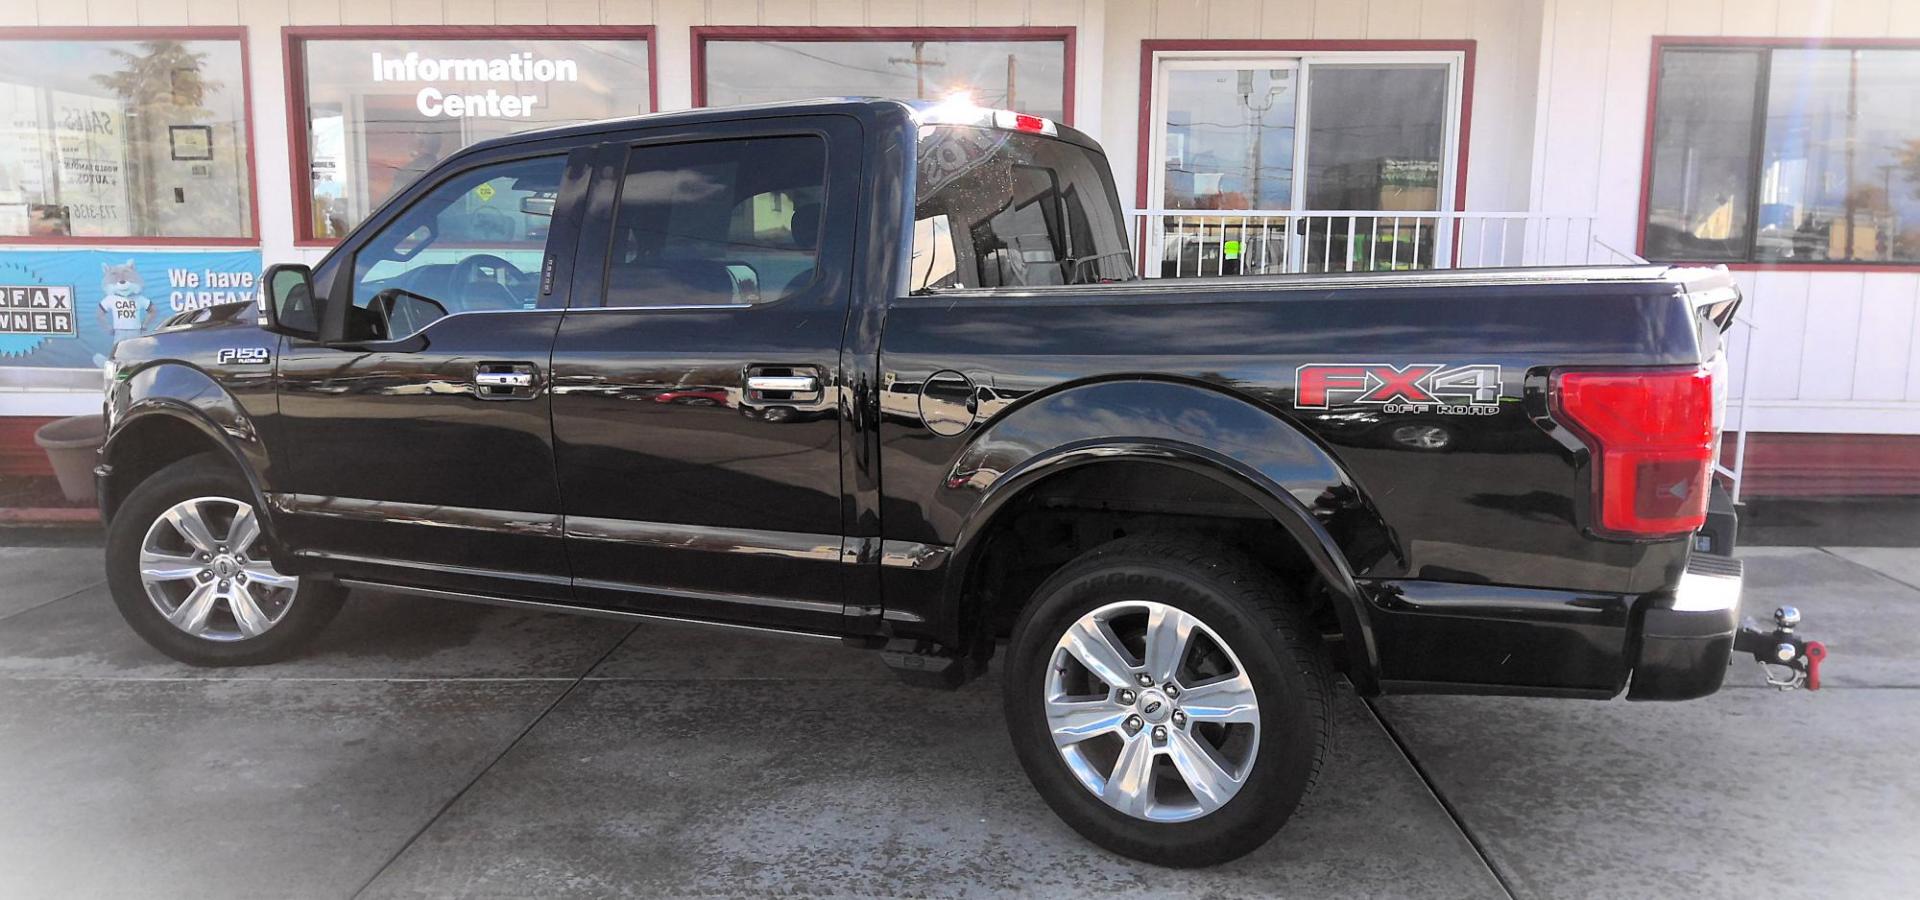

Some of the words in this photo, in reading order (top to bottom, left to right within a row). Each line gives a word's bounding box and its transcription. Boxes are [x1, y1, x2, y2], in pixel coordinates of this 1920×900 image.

[372, 52, 578, 82] Information
[416, 87, 538, 117] Center
[168, 268, 200, 288] We
[205, 268, 254, 288] have
[115, 300, 137, 310] CAR
[117, 309, 137, 319] FOX
[1294, 363, 1503, 409] FX4
[1383, 403, 1429, 414] OFF
[1436, 404, 1500, 416] ROAD
